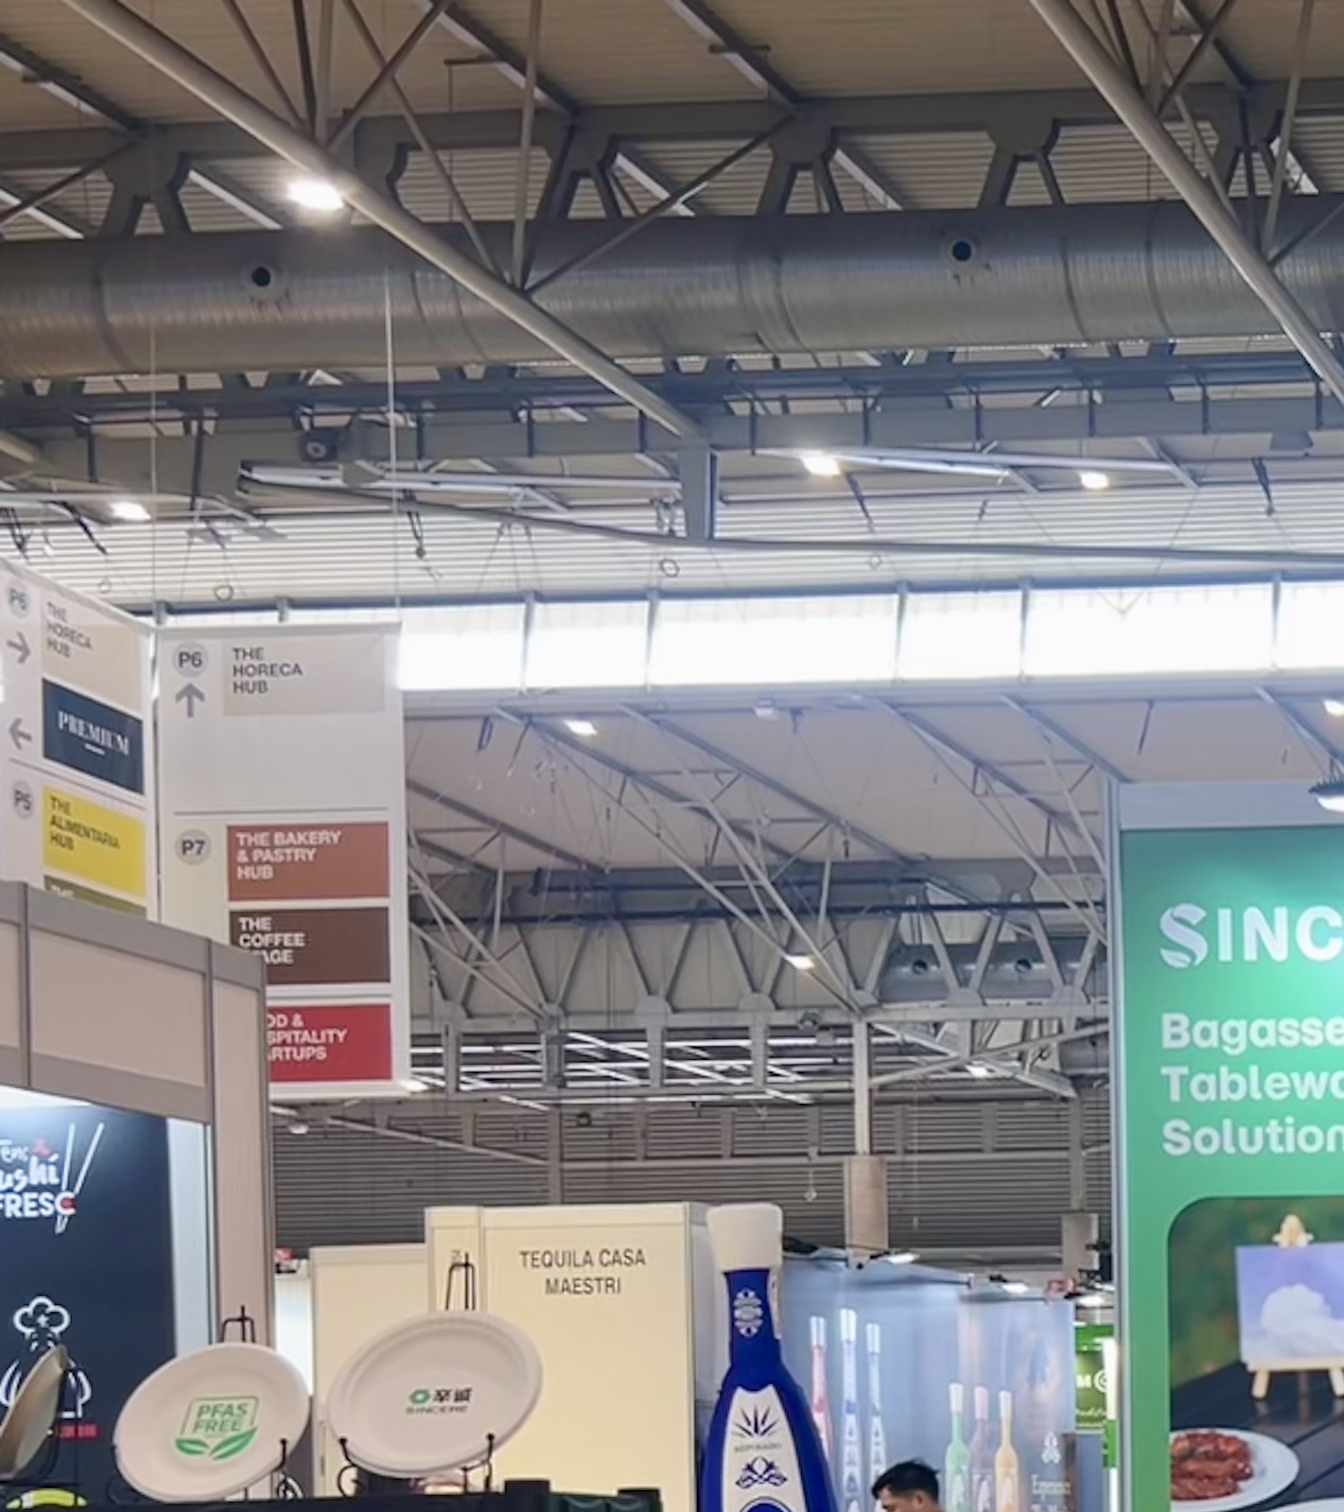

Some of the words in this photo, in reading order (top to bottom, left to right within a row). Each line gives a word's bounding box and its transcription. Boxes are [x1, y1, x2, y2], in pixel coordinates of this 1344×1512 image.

[46, 602, 68, 623] THE
[46, 619, 92, 651] HORECA
[46, 637, 71, 659] HUB
[232, 647, 264, 661] THE
[178, 652, 202, 668] P6
[232, 663, 303, 678] HORECA
[232, 680, 268, 694] HUB
[57, 710, 130, 756] PREMIUM
[50, 796, 72, 816] THE
[50, 816, 121, 850] ALIMENTARIA
[50, 831, 75, 851] HUB
[236, 832, 270, 848] THE
[274, 830, 341, 845] BAKERY
[181, 840, 205, 855] P7
[236, 850, 249, 863] &
[252, 848, 317, 863] PASTRY
[236, 865, 274, 880] HUB
[239, 916, 272, 931] THE
[239, 932, 305, 948] COFFEE
[254, 949, 294, 964] AGE
[266, 1014, 288, 1028] OD
[291, 1013, 303, 1027] &
[266, 1028, 347, 1045] SPITALITY
[267, 1046, 328, 1062] RTUPS
[520, 1250, 594, 1269] TEQUILA
[599, 1248, 647, 1267] CASA
[545, 1277, 622, 1295] MAESTRI
[197, 1402, 249, 1418] PFAS
[193, 1418, 242, 1434] FREE
